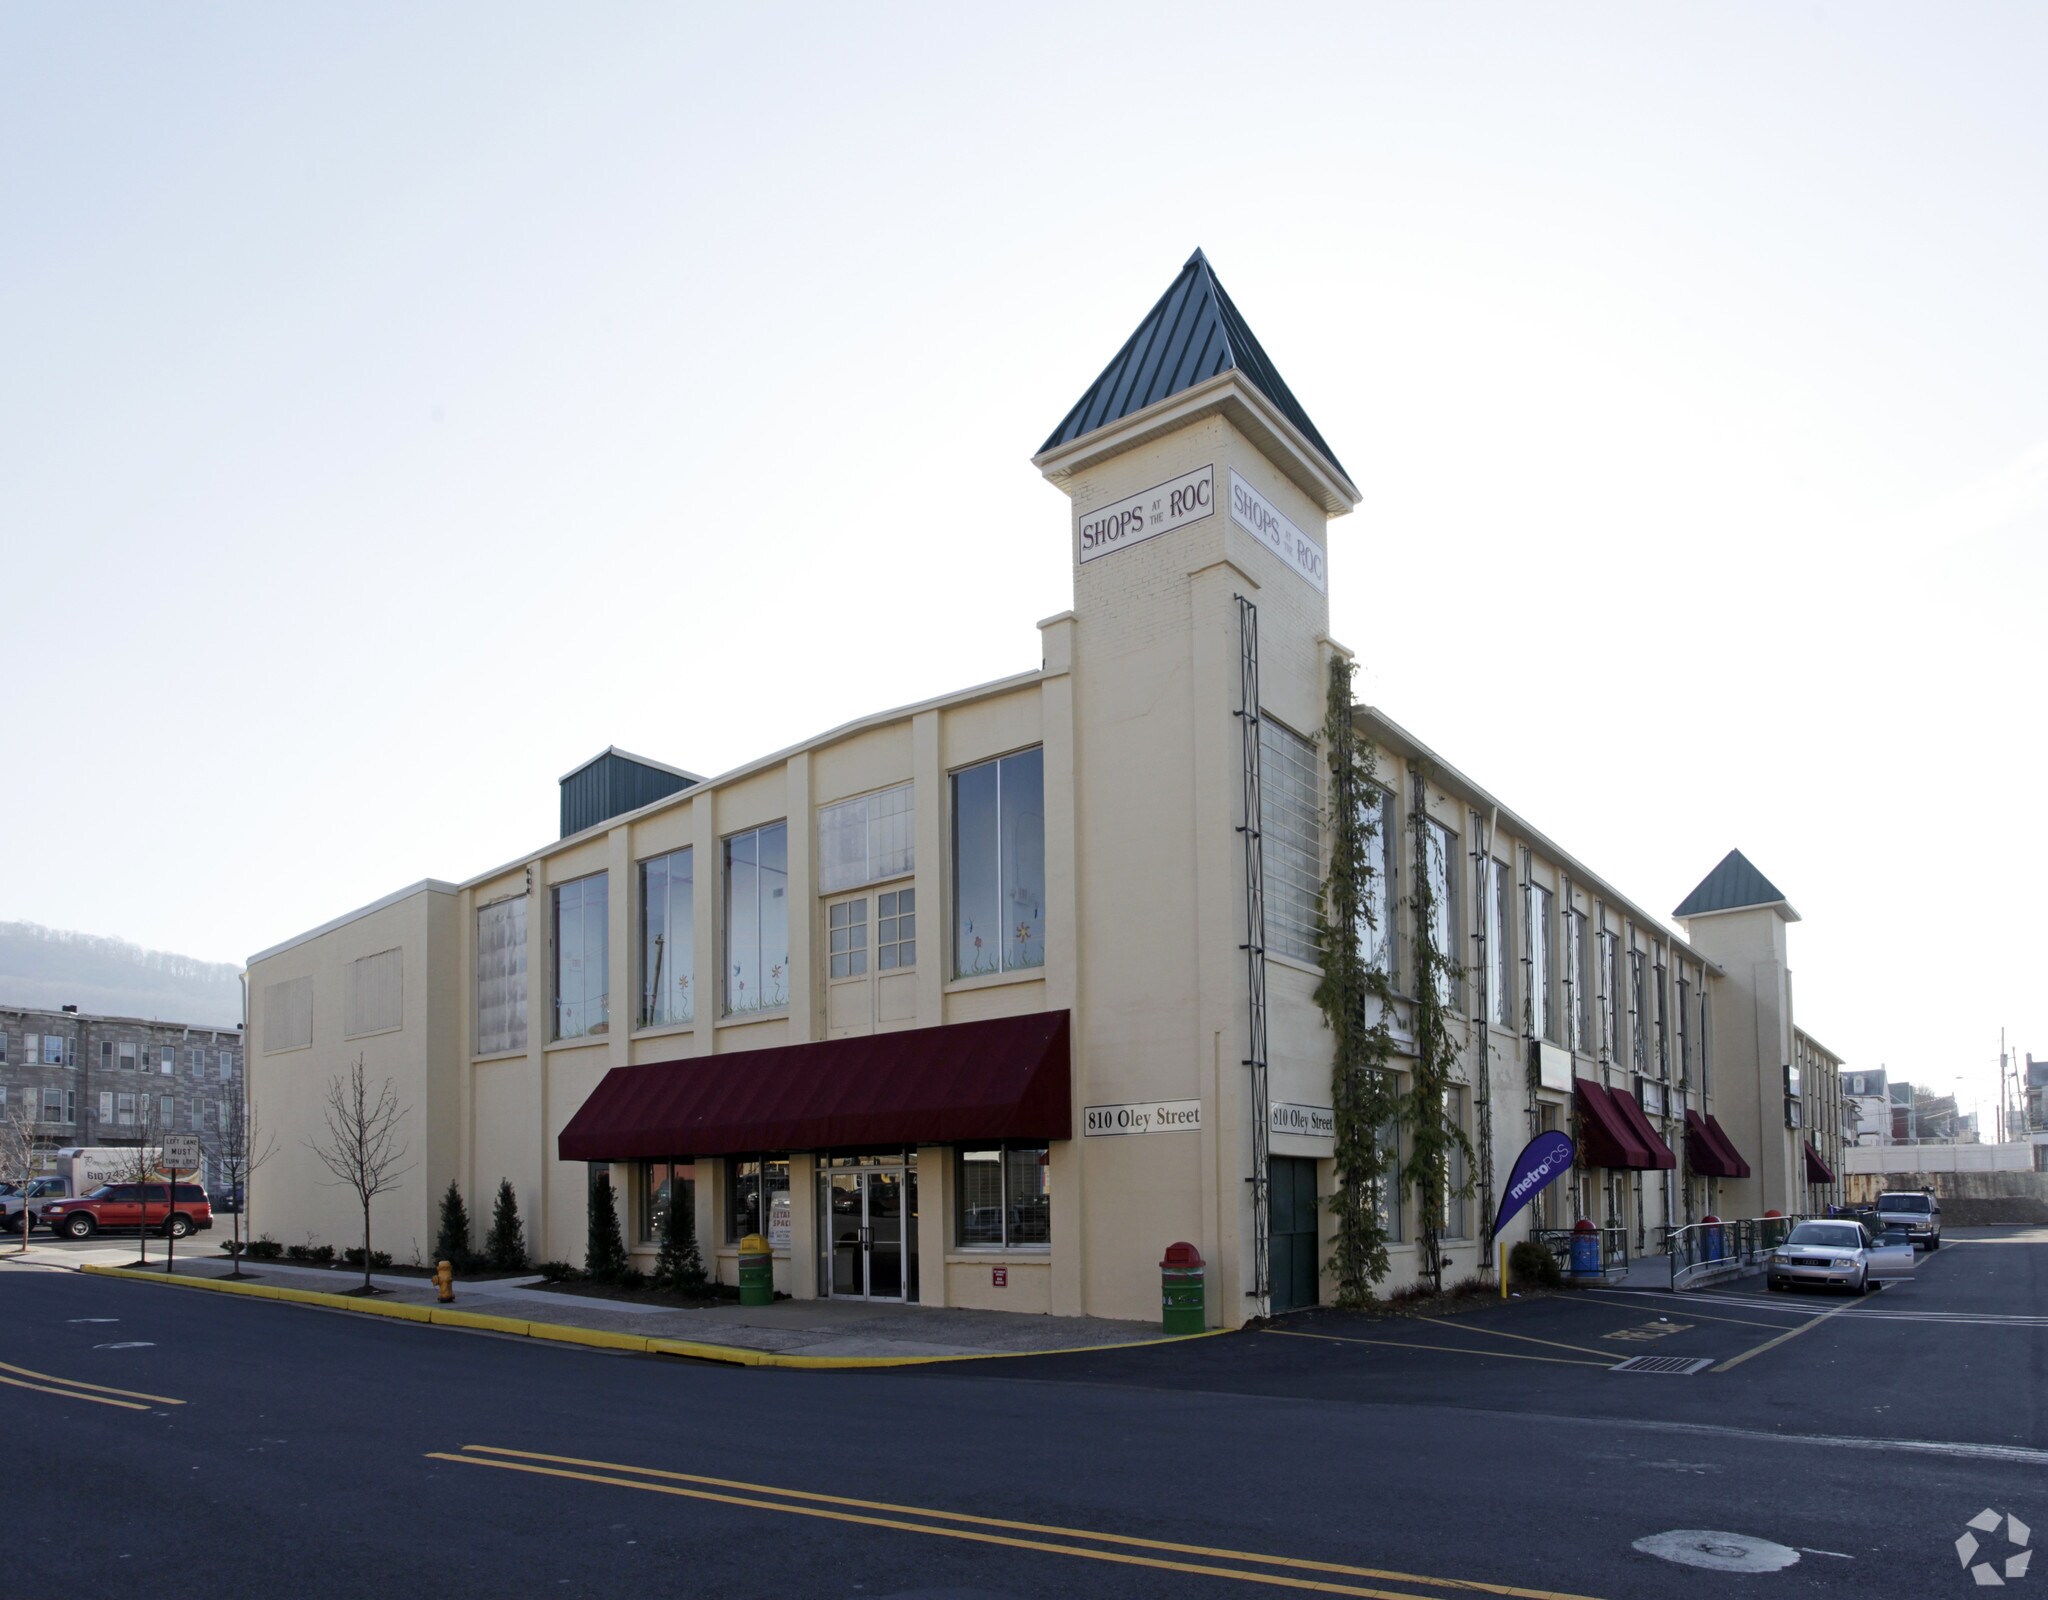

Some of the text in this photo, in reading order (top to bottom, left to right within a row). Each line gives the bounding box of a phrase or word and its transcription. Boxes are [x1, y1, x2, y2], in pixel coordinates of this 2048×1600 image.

[1151, 499, 1161, 511] AT
[1170, 480, 1210, 518] ROC
[1083, 506, 1144, 551] SHOPS
[1150, 512, 1164, 525] THE
[1235, 484, 1280, 546] SHOPS
[1297, 538, 1322, 580] ROC
[1088, 1107, 1200, 1133] 810 Oley Street
[1273, 1108, 1333, 1135] 810 Oley Street
[171, 1148, 191, 1156] MUST
[87, 1171, 104, 1180] 610
[1510, 1143, 1569, 1200] metroPCS
